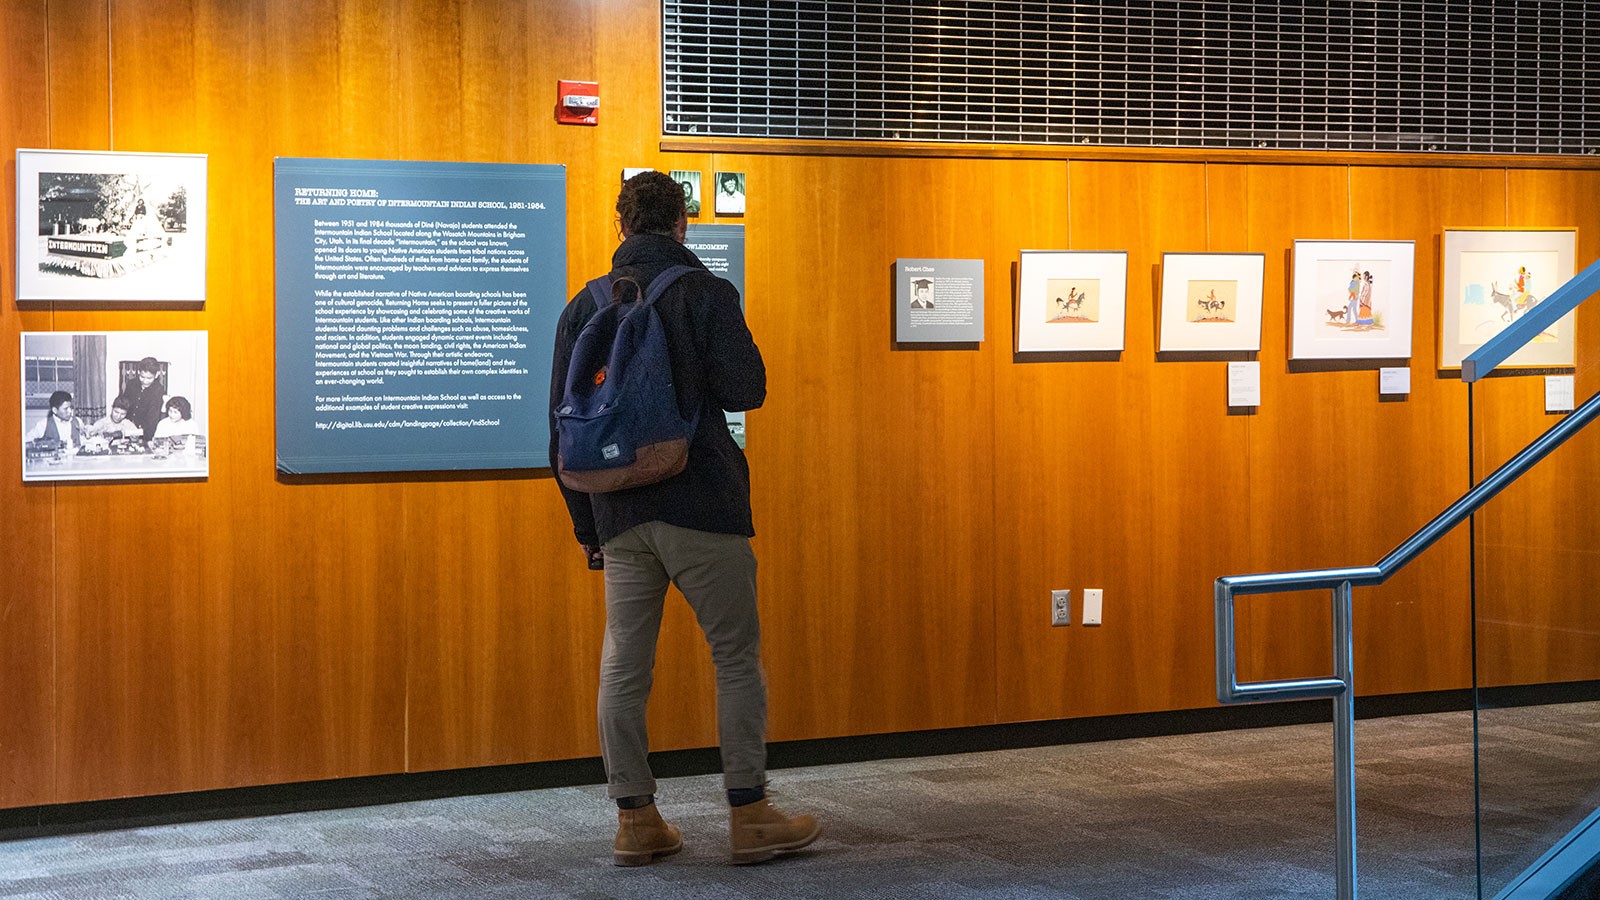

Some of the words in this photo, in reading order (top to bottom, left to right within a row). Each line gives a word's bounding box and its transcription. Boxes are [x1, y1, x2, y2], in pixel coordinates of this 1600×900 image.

[295, 188, 348, 196] RETURNING
[388, 199, 449, 208] INTERMOUNTAIN
[478, 201, 508, 209] SCHOOL,
[415, 229, 432, 239] along
[503, 230, 525, 240] Brigham
[48, 240, 108, 254] INTERMOUNTAIN
[369, 264, 403, 273] encouraged
[404, 264, 412, 273] by
[315, 272, 337, 281] through
[455, 290, 480, 299] boarding
[425, 316, 451, 325] boarding
[356, 324, 381, 333] daunting
[382, 324, 408, 334] problems
[421, 324, 450, 334] challenges
[405, 333, 430, 342] engaged
[431, 333, 454, 342] dynamic
[493, 333, 517, 342] including
[409, 350, 431, 360] Through
[400, 359, 425, 368] insightful
[345, 403, 372, 412] examples
[424, 402, 455, 411] expressions
